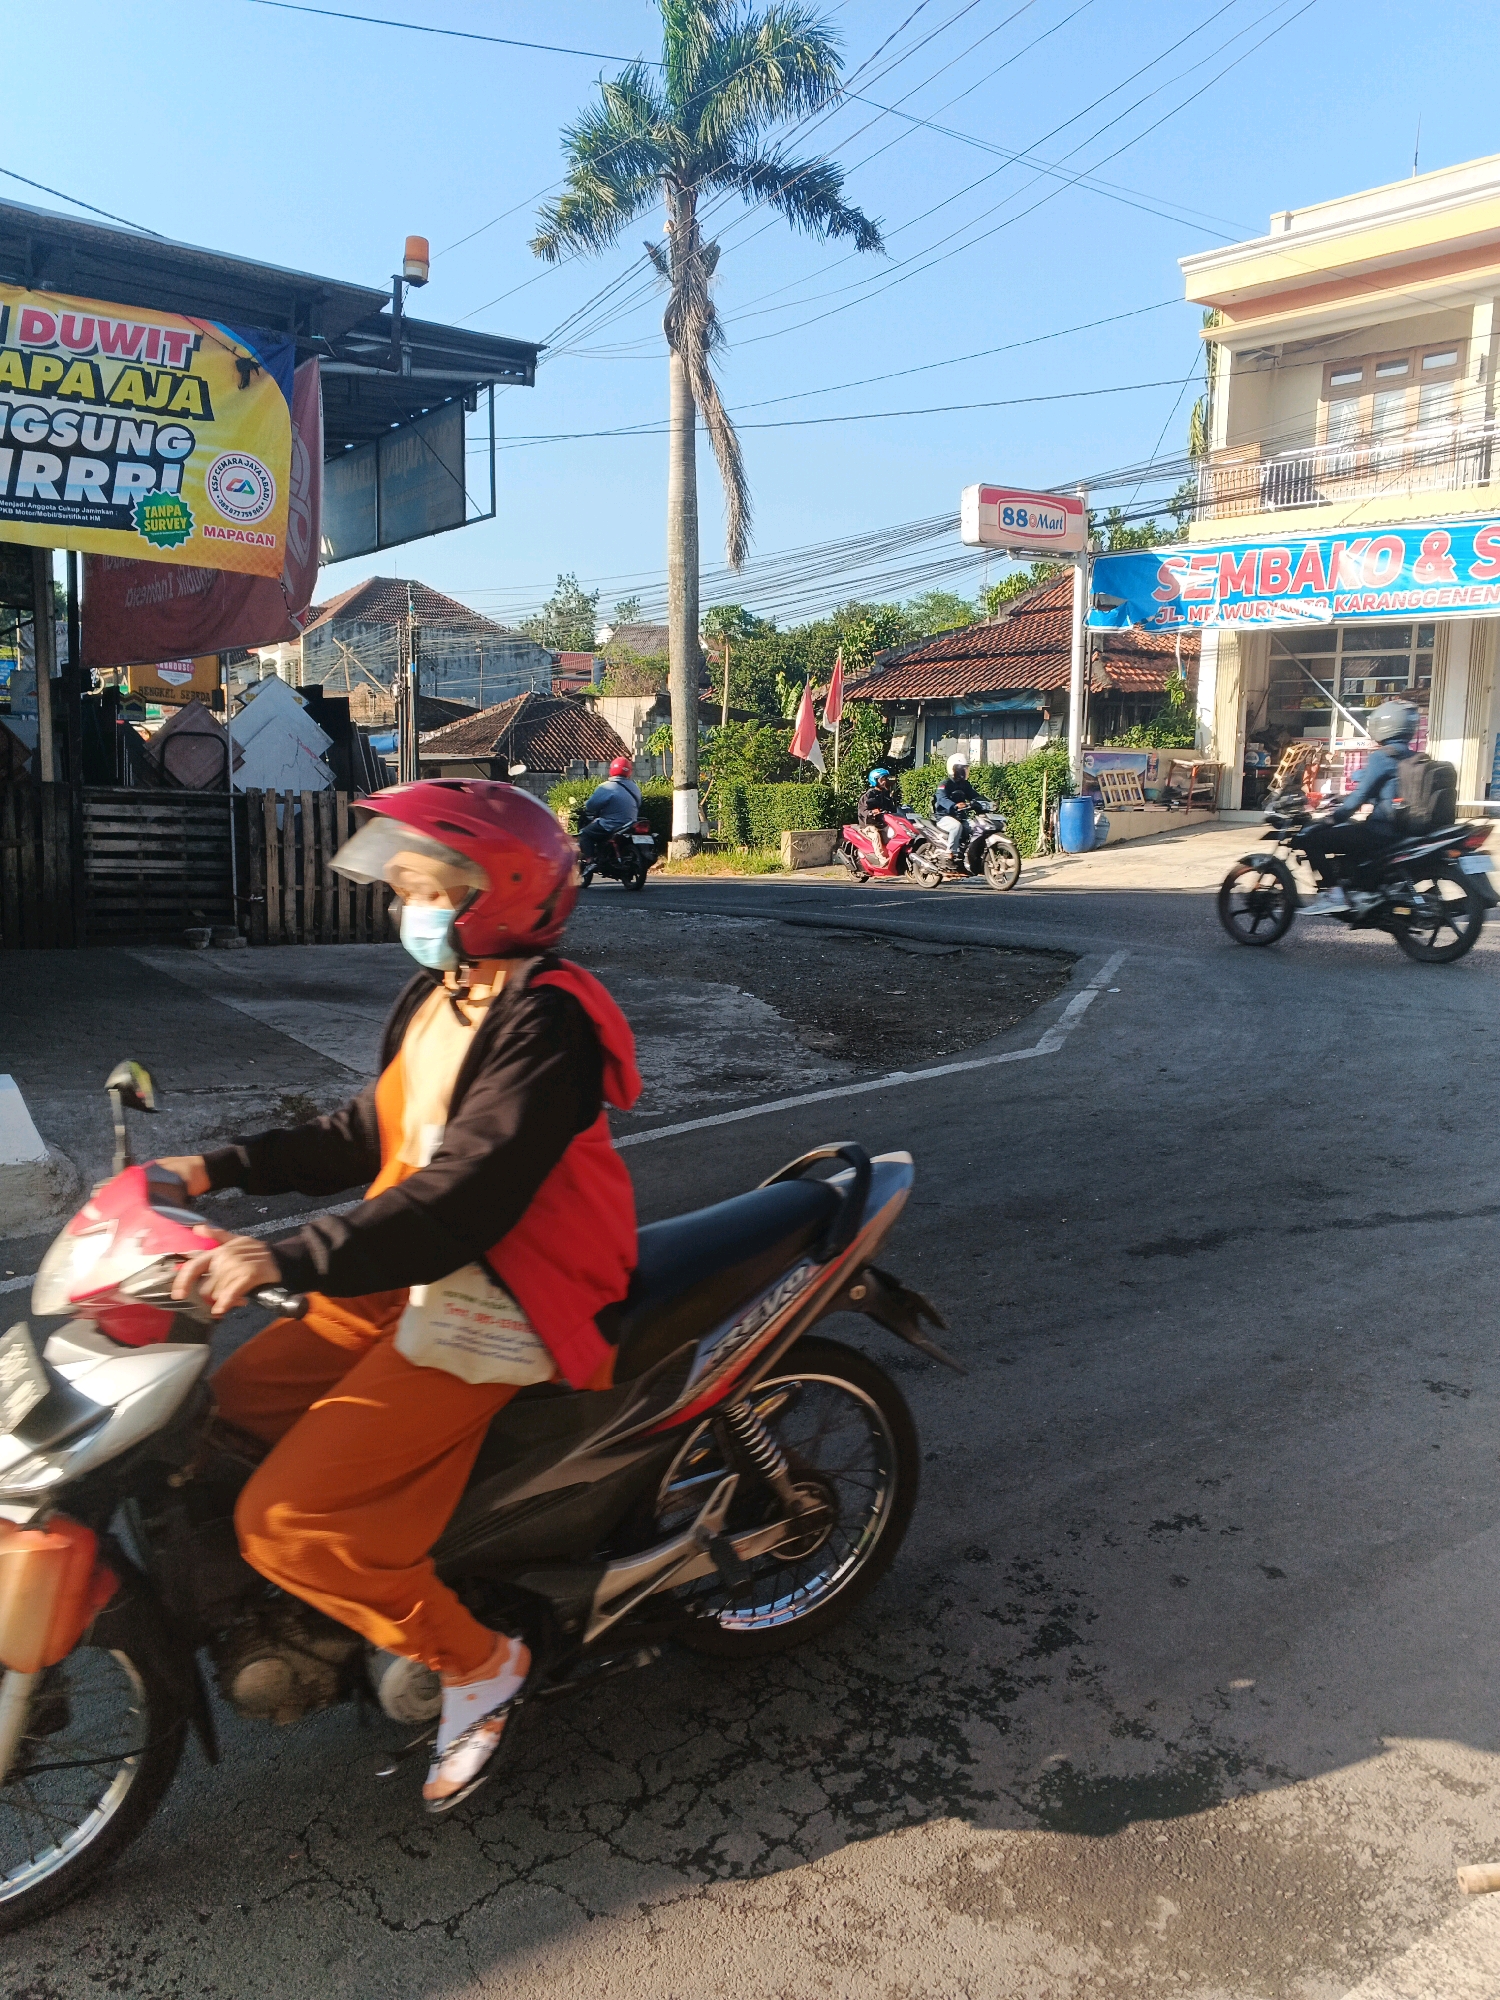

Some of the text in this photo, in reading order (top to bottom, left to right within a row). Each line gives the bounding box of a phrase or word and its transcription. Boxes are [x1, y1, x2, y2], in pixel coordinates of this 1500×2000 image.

[18, 307, 192, 365] DUWIT
[109, 369, 204, 415] AJA
[0, 404, 192, 459] GSUNG
[211, 458, 270, 502] KSP CEMARA JAYA ABADI
[28, 502, 56, 510] Anggota
[58, 505, 80, 514] Cukup
[82, 506, 114, 516] Jaminkan
[143, 505, 182, 518] TANPA
[1003, 507, 1063, 530] 88 Mart
[144, 517, 187, 532] SURVEY
[204, 525, 275, 547] MAPAGAN
[1152, 536, 1404, 600] SEMBAKO
[1414, 531, 1457, 583] &
[1155, 607, 1184, 623] JL.
[139, 686, 176, 699] BENGKEL
